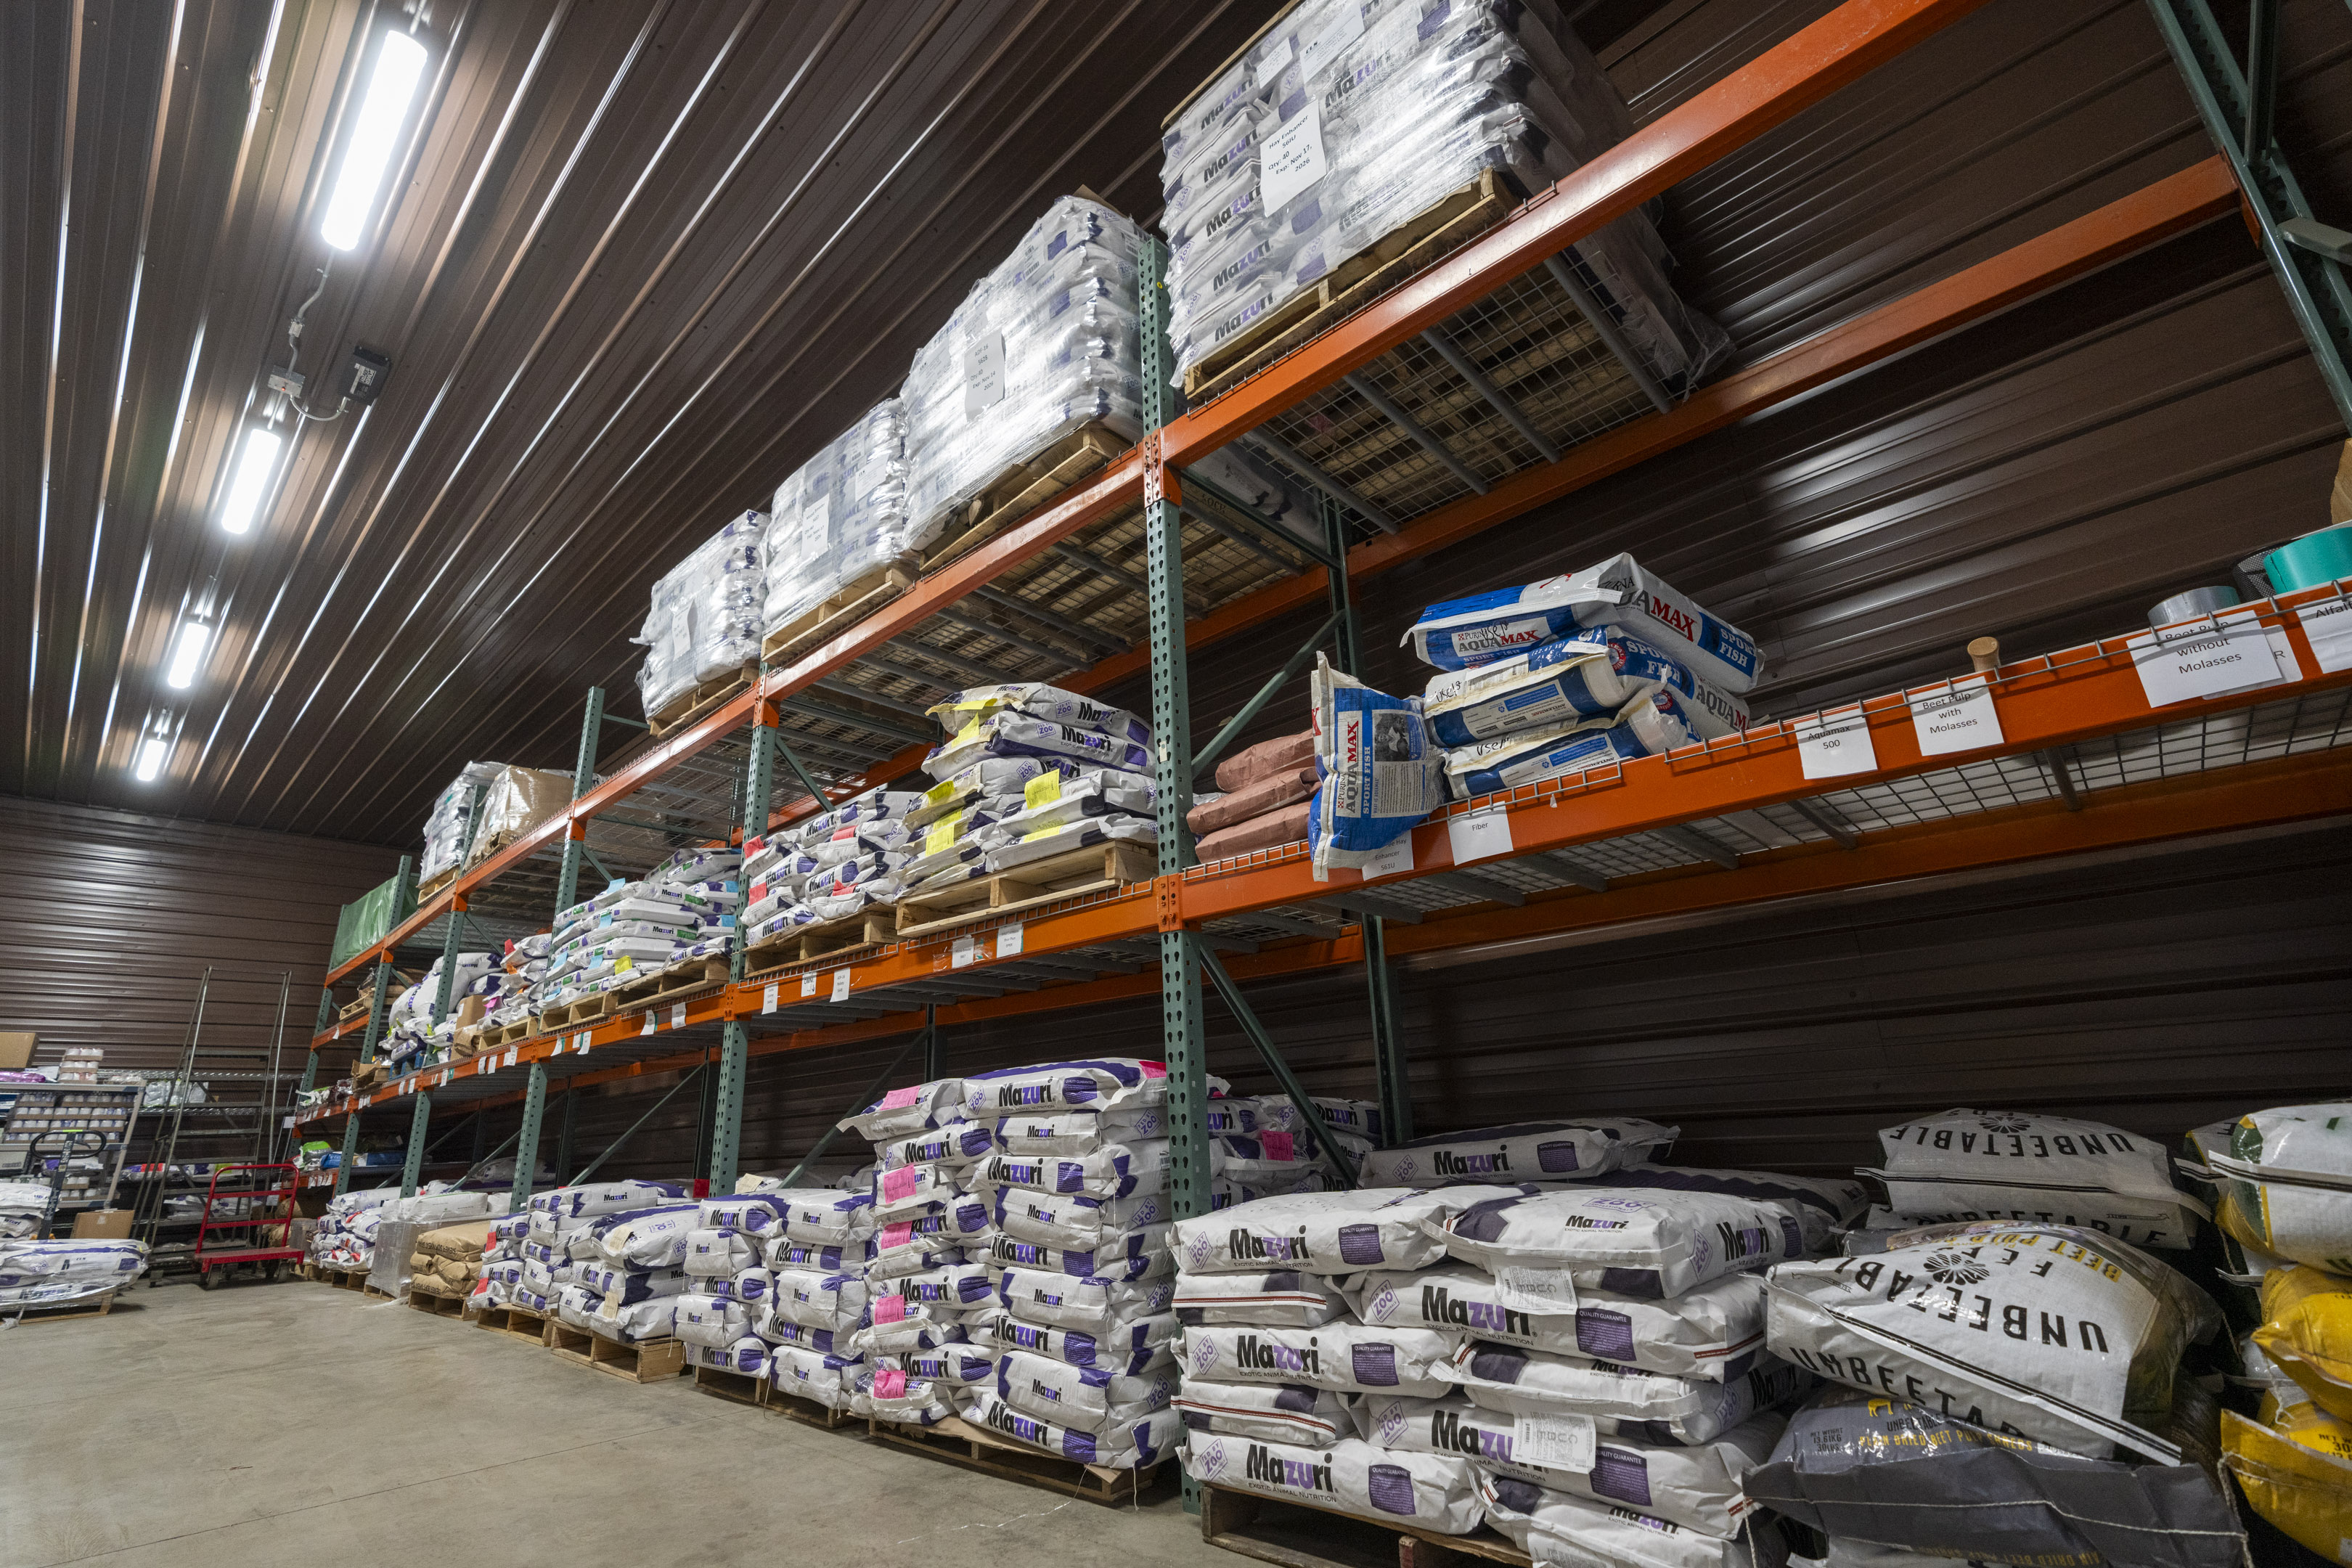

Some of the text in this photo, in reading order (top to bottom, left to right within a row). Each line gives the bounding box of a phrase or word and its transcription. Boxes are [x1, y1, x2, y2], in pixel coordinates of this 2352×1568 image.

[1201, 78, 1254, 131] Mazuri
[1269, 115, 1309, 150] Hay Enhancer
[1204, 128, 1258, 183] Mazuri
[1268, 150, 1290, 171] Qty: 40
[1276, 163, 1290, 175] Exp:
[1290, 153, 1302, 166] Nov
[1295, 158, 1310, 171] 2026
[1213, 240, 1271, 292] Mazuri
[1215, 292, 1273, 343] Mazuri
[1458, 629, 1542, 653] AQUAMAX
[1720, 628, 1756, 656] SPORT
[2176, 636, 2231, 657] without
[1463, 653, 1495, 662] SPORT
[1719, 642, 1748, 667] FISH
[2179, 653, 2242, 674] Molasses
[1057, 705, 1072, 714] ZOO
[1922, 691, 1972, 711] Beet Pulp
[1938, 708, 1961, 719] with
[1039, 726, 1053, 735] ZOO
[1808, 725, 1850, 741] Aquamax
[1930, 718, 1978, 735] Molasses
[1061, 725, 1111, 752] Mazuri
[1823, 739, 1841, 750] 500
[953, 764, 976, 782] Mazuri
[1021, 765, 1033, 779] ZOO
[1347, 720, 1360, 814] AQUAMAX
[807, 814, 835, 837] Mazuri
[1471, 822, 1489, 831] Fiber
[1396, 838, 1408, 848] Hay
[1375, 850, 1400, 861] Enhancer
[766, 859, 791, 886] Mazuri
[809, 871, 835, 892] Mazuri
[661, 889, 682, 898] Mazuri
[653, 926, 674, 934] Mazuri
[763, 916, 789, 937] Mazuri
[999, 1076, 1053, 1107] Mazuri
[1027, 1124, 1055, 1138] Mazuri
[1141, 1114, 1157, 1134] ZOO
[905, 1132, 950, 1163] Mazuri
[1890, 1125, 2136, 1158] UNBEETABLE
[1397, 1162, 1415, 1180] ZOO
[1434, 1145, 1508, 1176] Mazuri
[987, 1157, 1043, 1188] Mazuri
[604, 1192, 627, 1201] Mazuri
[1594, 1197, 1642, 1208] ZOO
[710, 1207, 740, 1226] Mazuri
[802, 1212, 821, 1224] Mazuri
[1027, 1204, 1055, 1224] Mazuri
[1139, 1205, 1156, 1226] ZOO
[1565, 1215, 1628, 1230] Mazuri
[496, 1222, 513, 1237] Mazuri
[1715, 1214, 1770, 1262] Mazuri
[695, 1243, 710, 1254] Mazuri
[775, 1242, 815, 1264] Mazuri
[992, 1235, 1048, 1267] Mazuri
[1193, 1241, 1207, 1260] ZOO
[1229, 1225, 1310, 1260] Mazuri
[2051, 1240, 2123, 1283] BEET
[489, 1267, 505, 1281] Mazuri
[581, 1263, 603, 1285] Mazuri
[515, 1286, 534, 1305] Mazuri
[704, 1275, 738, 1297] Mazuri
[793, 1289, 810, 1303] Mazuri
[899, 1275, 950, 1302] Mazuri
[1150, 1286, 1168, 1307] ZOO
[1034, 1289, 1063, 1307] Mazuri
[1373, 1291, 1394, 1316] ZOO
[1834, 1257, 2110, 1354] UNBEETABL
[687, 1312, 703, 1323] Mazuri
[1421, 1284, 1530, 1337] Mazuri
[1600, 1312, 1627, 1323] GUARANTEE
[768, 1314, 805, 1342] Mazuri
[992, 1315, 1050, 1352] Mazuri
[1425, 1323, 1534, 1346] EXOTIC NUTRITION
[702, 1345, 735, 1368] Mazuri
[900, 1351, 950, 1379] Mazuri
[1198, 1345, 1214, 1365] ZOO
[1237, 1335, 1320, 1374] Mazuri
[794, 1365, 809, 1381] Mazuri
[1032, 1379, 1062, 1402] Mazuri
[1153, 1380, 1168, 1405] ZOO
[988, 1400, 1048, 1447] Mazuri
[1381, 1413, 1401, 1438] ZOO
[1893, 1432, 1926, 1447] DRIED
[1931, 1430, 1951, 1445] BEET
[1957, 1429, 1983, 1443] PULP
[1205, 1450, 1223, 1469] ZOO
[1247, 1444, 1334, 1493] Mazuri
[1613, 1452, 1642, 1464] GUARANTEE
[1503, 1464, 1546, 1482] NUTRITION
[1248, 1482, 1337, 1503] EXOTIC ANIMAL NUTRITION
[1608, 1516, 1675, 1539] EXOTIC ANIMAL NUTRITION
